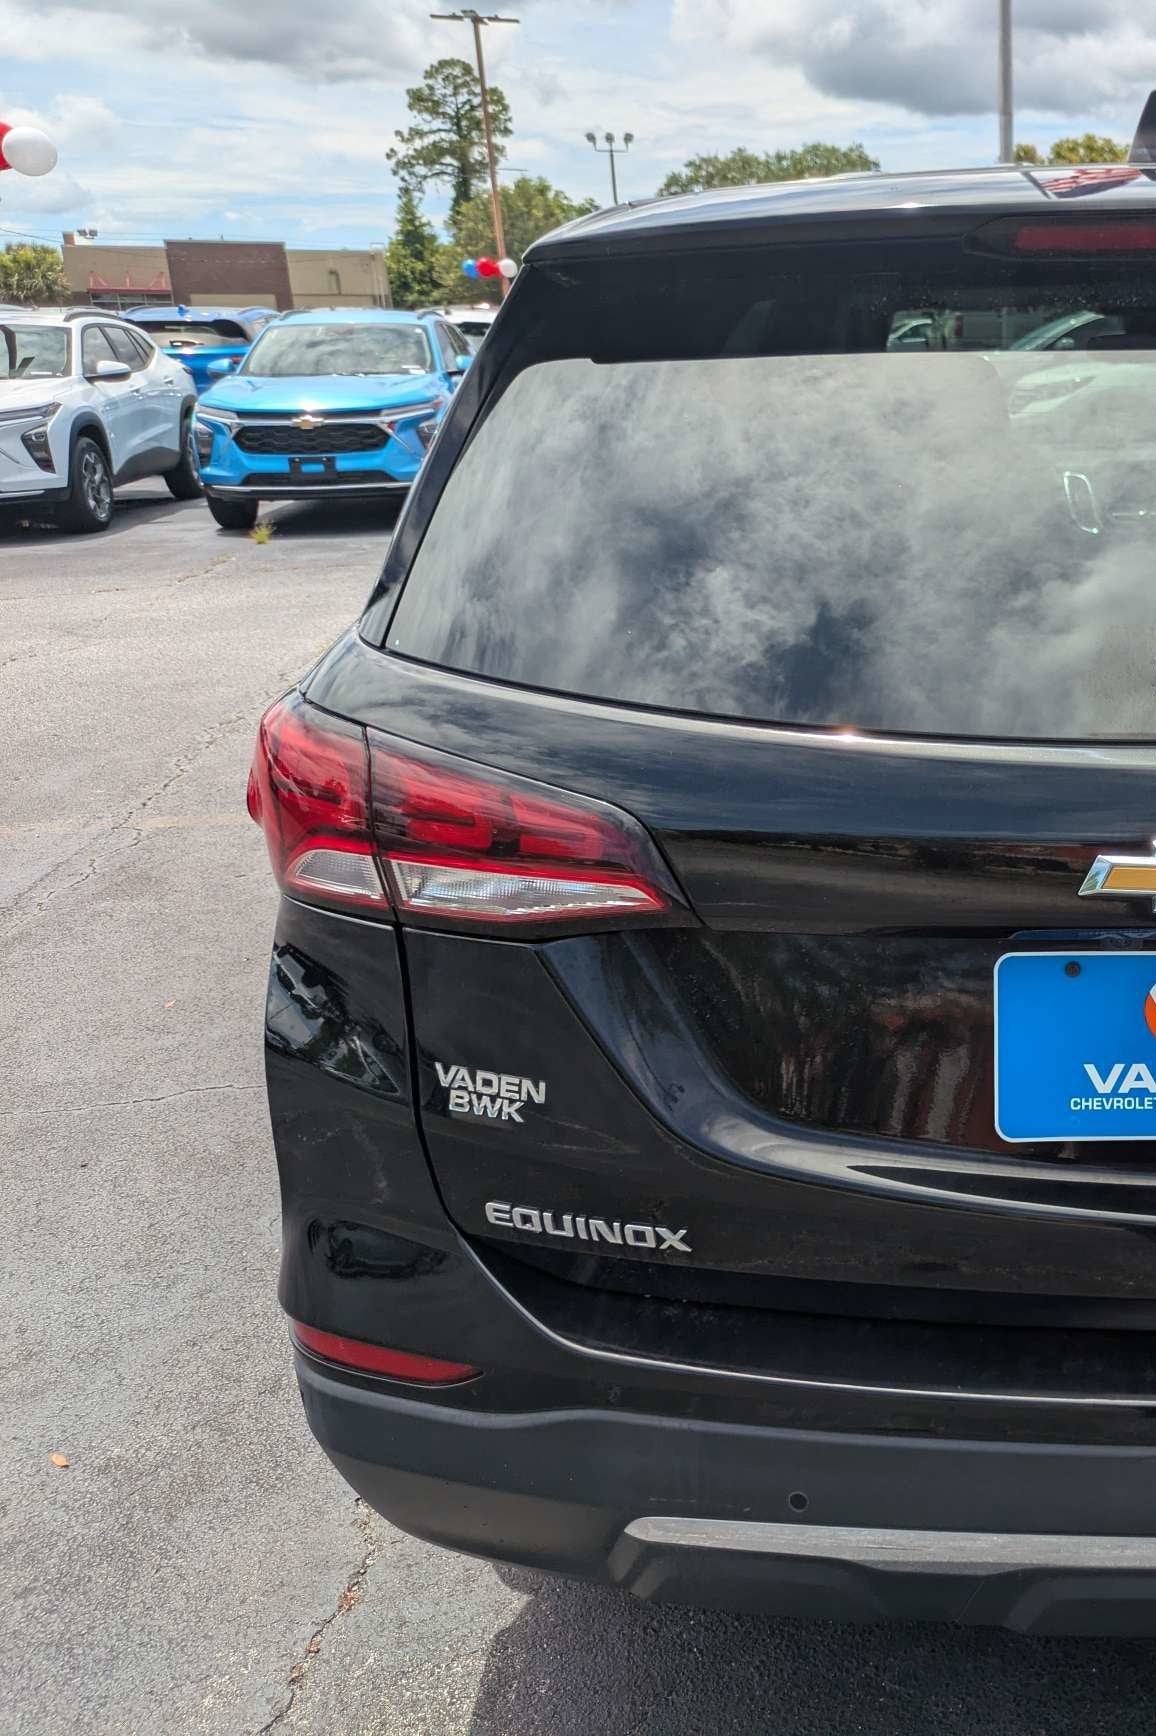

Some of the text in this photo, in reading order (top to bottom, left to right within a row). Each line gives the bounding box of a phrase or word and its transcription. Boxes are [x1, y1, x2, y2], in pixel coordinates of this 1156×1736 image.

[434, 1061, 546, 1104] VADEN
[449, 1089, 524, 1123] BWK
[484, 1201, 692, 1252] EQUINOX
